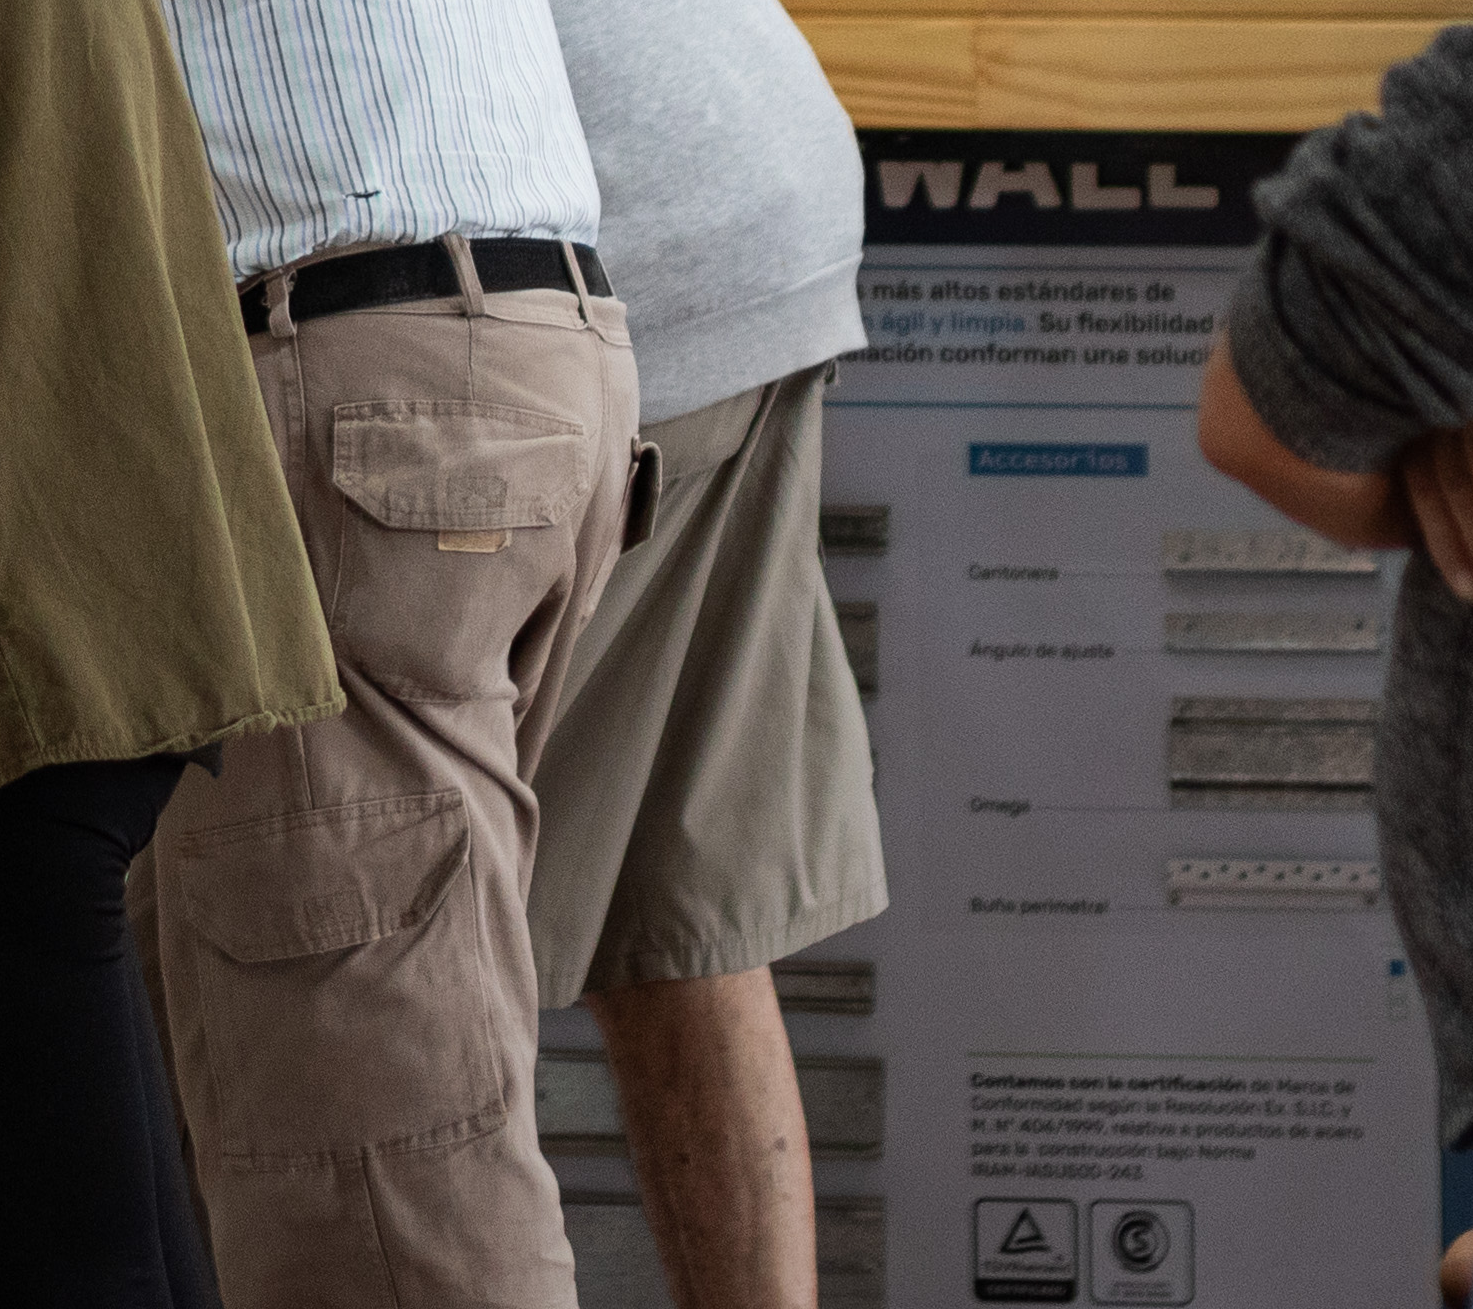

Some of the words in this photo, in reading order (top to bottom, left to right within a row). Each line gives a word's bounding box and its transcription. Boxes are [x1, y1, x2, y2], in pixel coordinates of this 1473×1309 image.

[878, 161, 1219, 209] WALL
[872, 283, 923, 302] más
[931, 281, 990, 301] altos
[998, 281, 1137, 302] estándares
[1145, 281, 1176, 302] de
[1040, 314, 1070, 333] Su
[1078, 313, 1214, 333] flexibilidad
[940, 344, 1075, 363] conforman
[1083, 347, 1130, 363] una
[978, 449, 1129, 471] Accesorios
[971, 1073, 1065, 1090] Contamos
[1129, 1076, 1246, 1093] certificación
